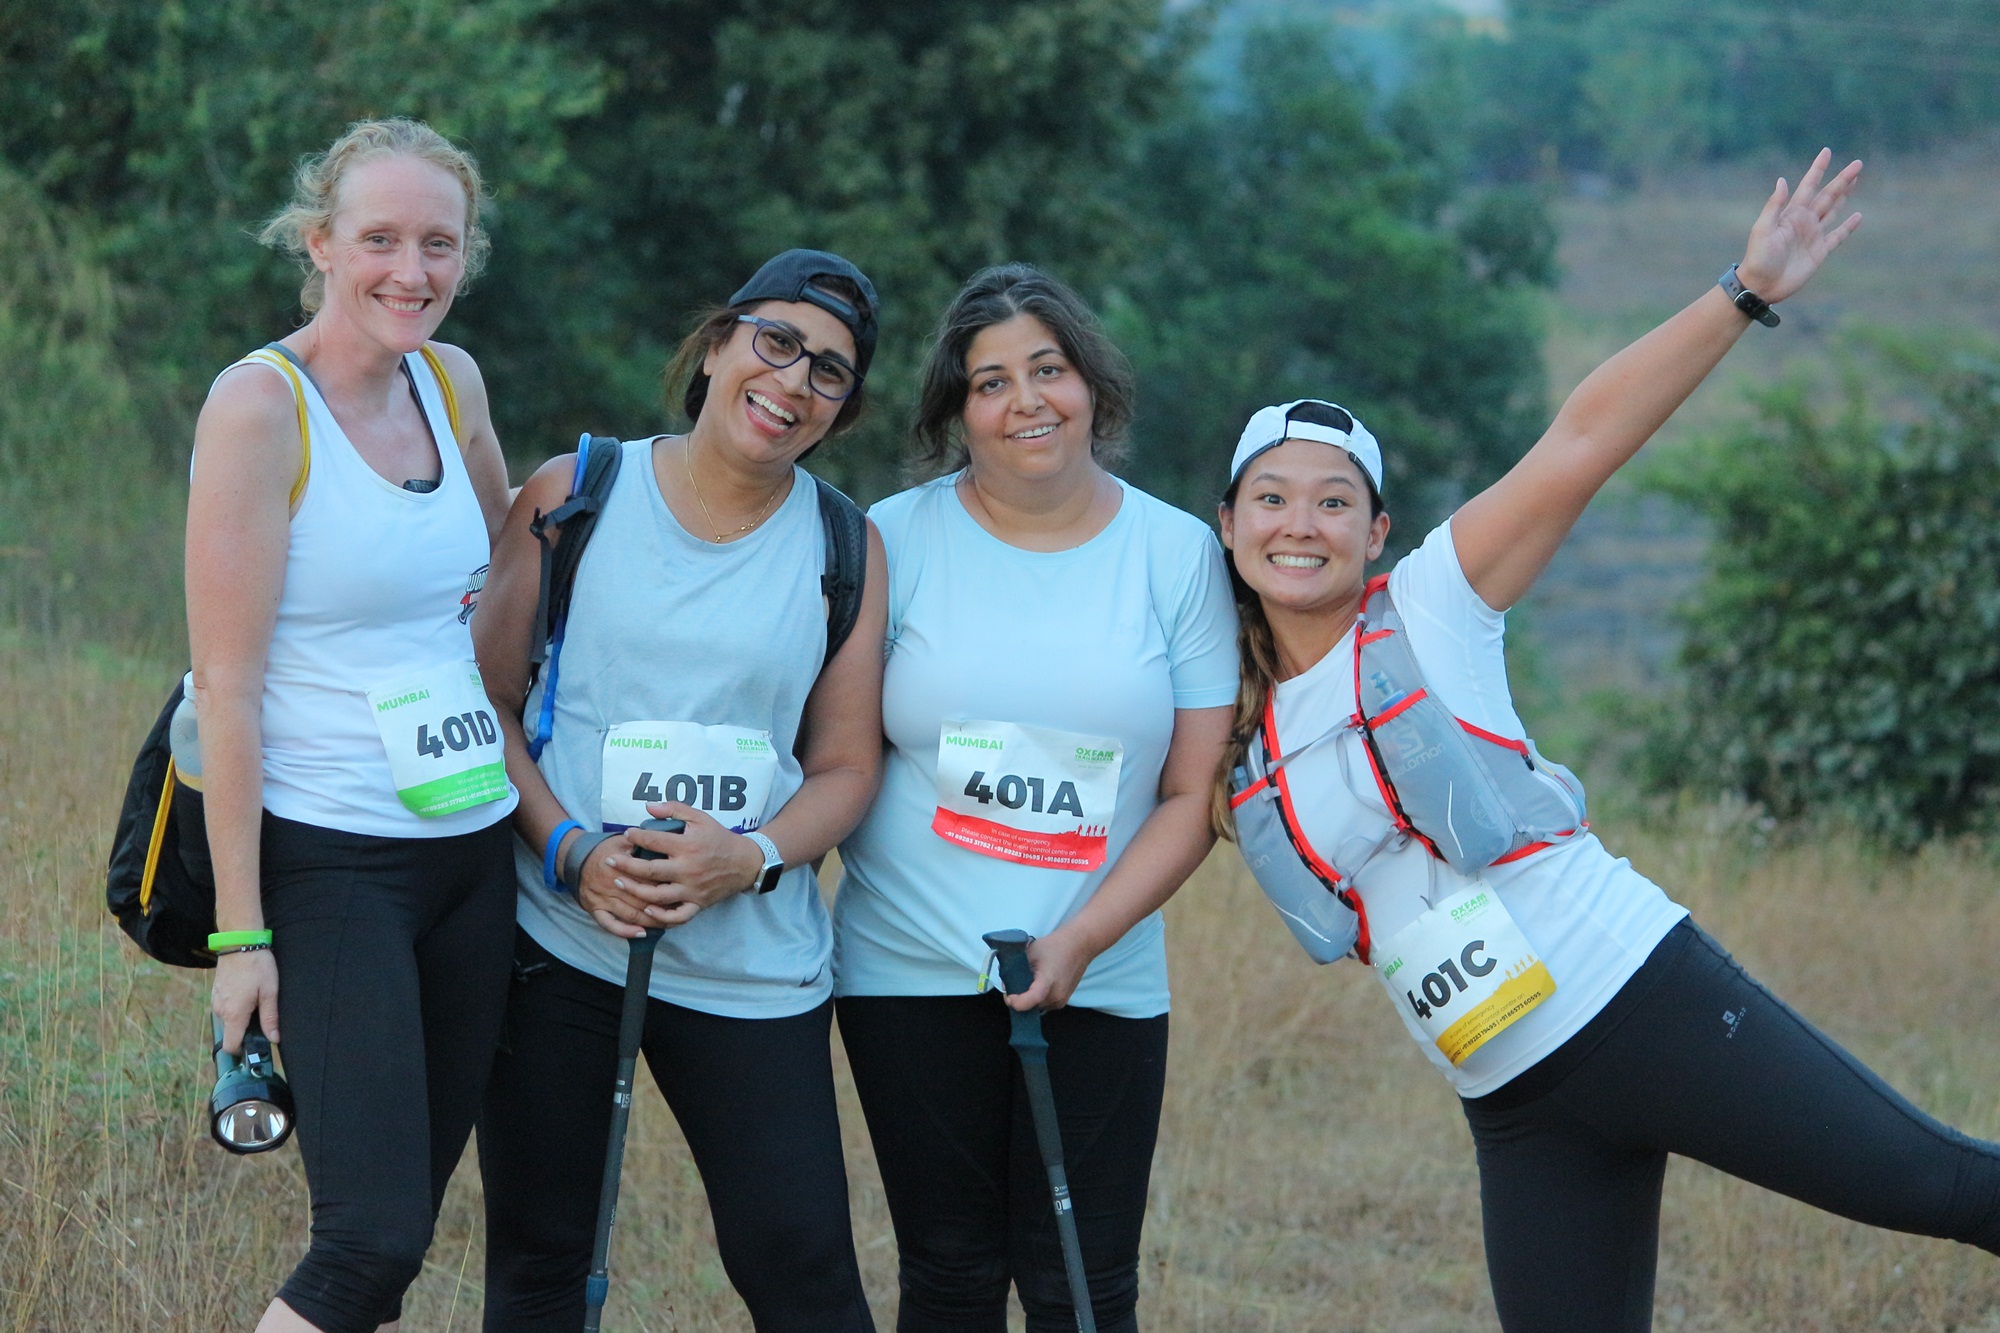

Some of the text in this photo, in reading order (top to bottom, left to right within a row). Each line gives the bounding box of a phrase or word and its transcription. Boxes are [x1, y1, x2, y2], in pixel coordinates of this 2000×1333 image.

[376, 689, 430, 712] MUMBAI
[417, 710, 497, 759] 401D
[609, 738, 668, 750] MUMBAI
[736, 738, 768, 747] OXFAM
[946, 735, 1003, 750] MUMBAI
[1076, 747, 1114, 758] OXFAM
[632, 772, 748, 811] 401B
[964, 770, 1084, 818] 401A
[961, 827, 980, 837] Please
[1450, 892, 1487, 917] OXFAM
[1407, 940, 1498, 1020] 401C
